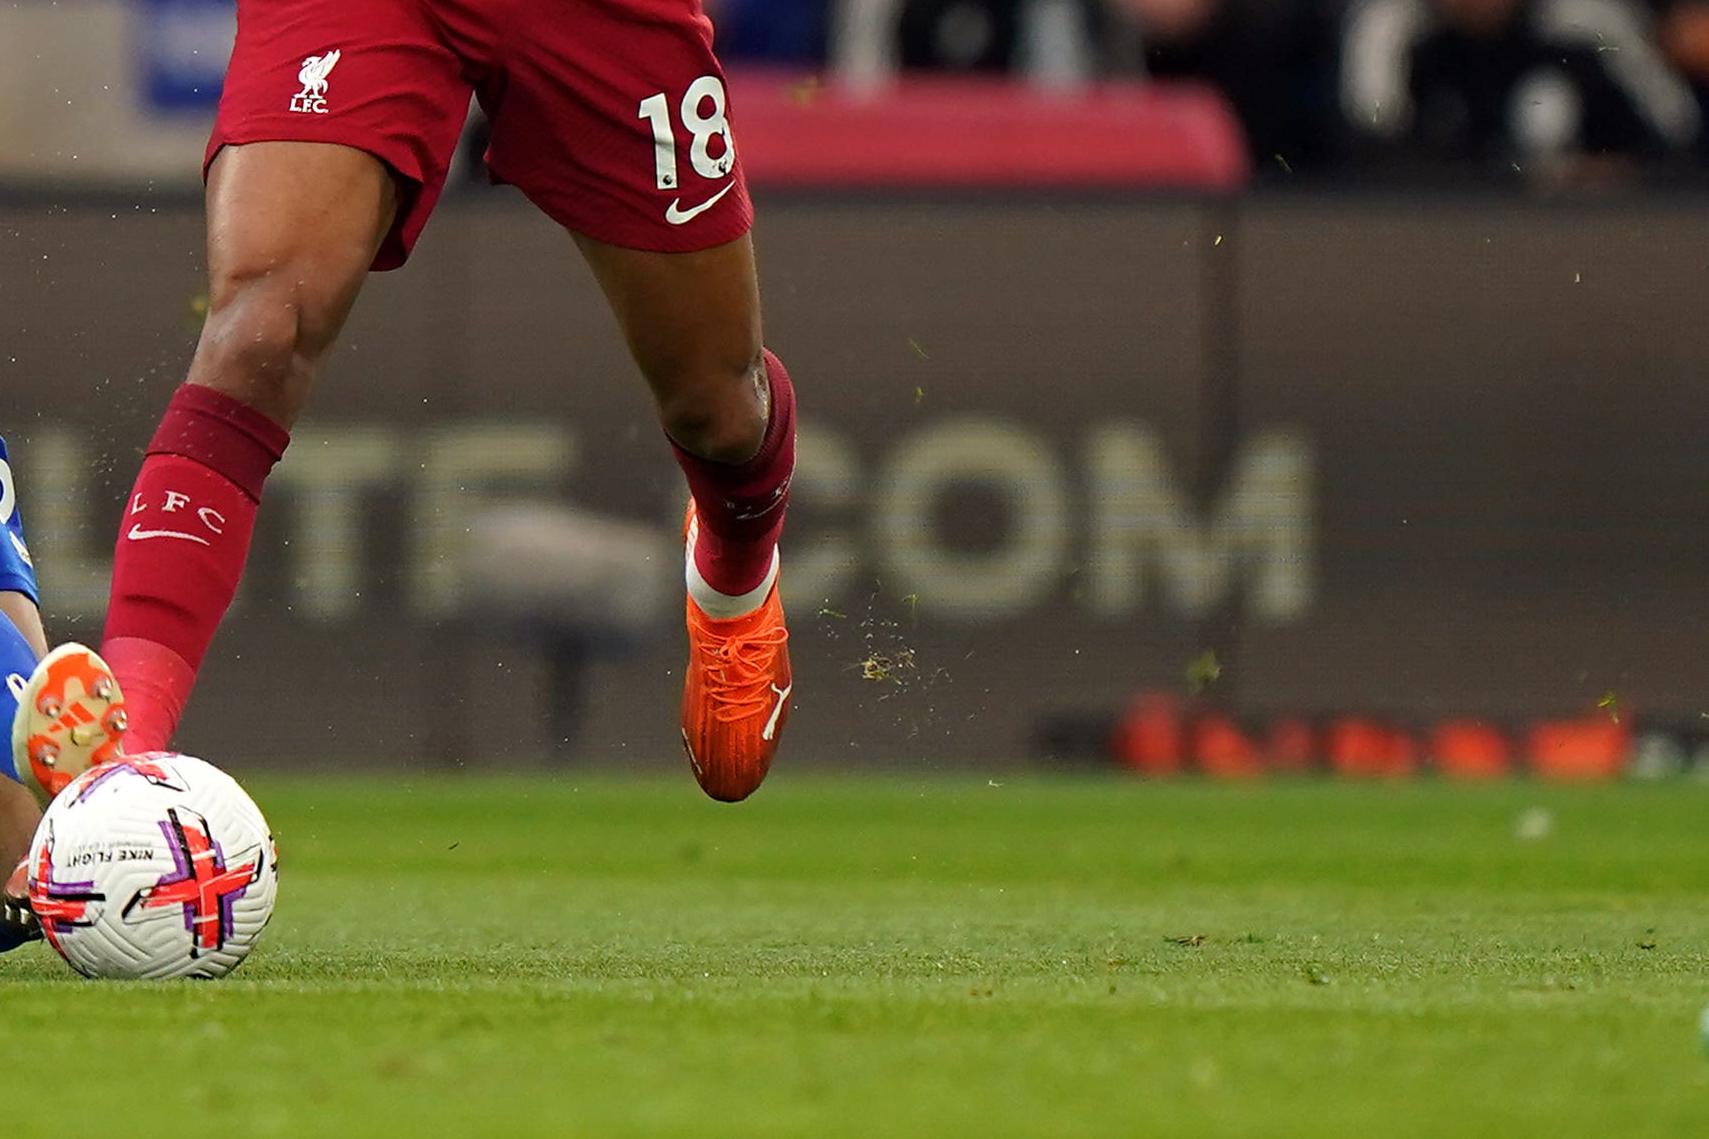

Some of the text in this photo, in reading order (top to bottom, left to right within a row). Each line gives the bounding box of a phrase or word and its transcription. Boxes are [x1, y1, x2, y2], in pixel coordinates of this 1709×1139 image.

[638, 75, 736, 190] 18
[66, 849, 154, 868] NIKE FLIGHT
